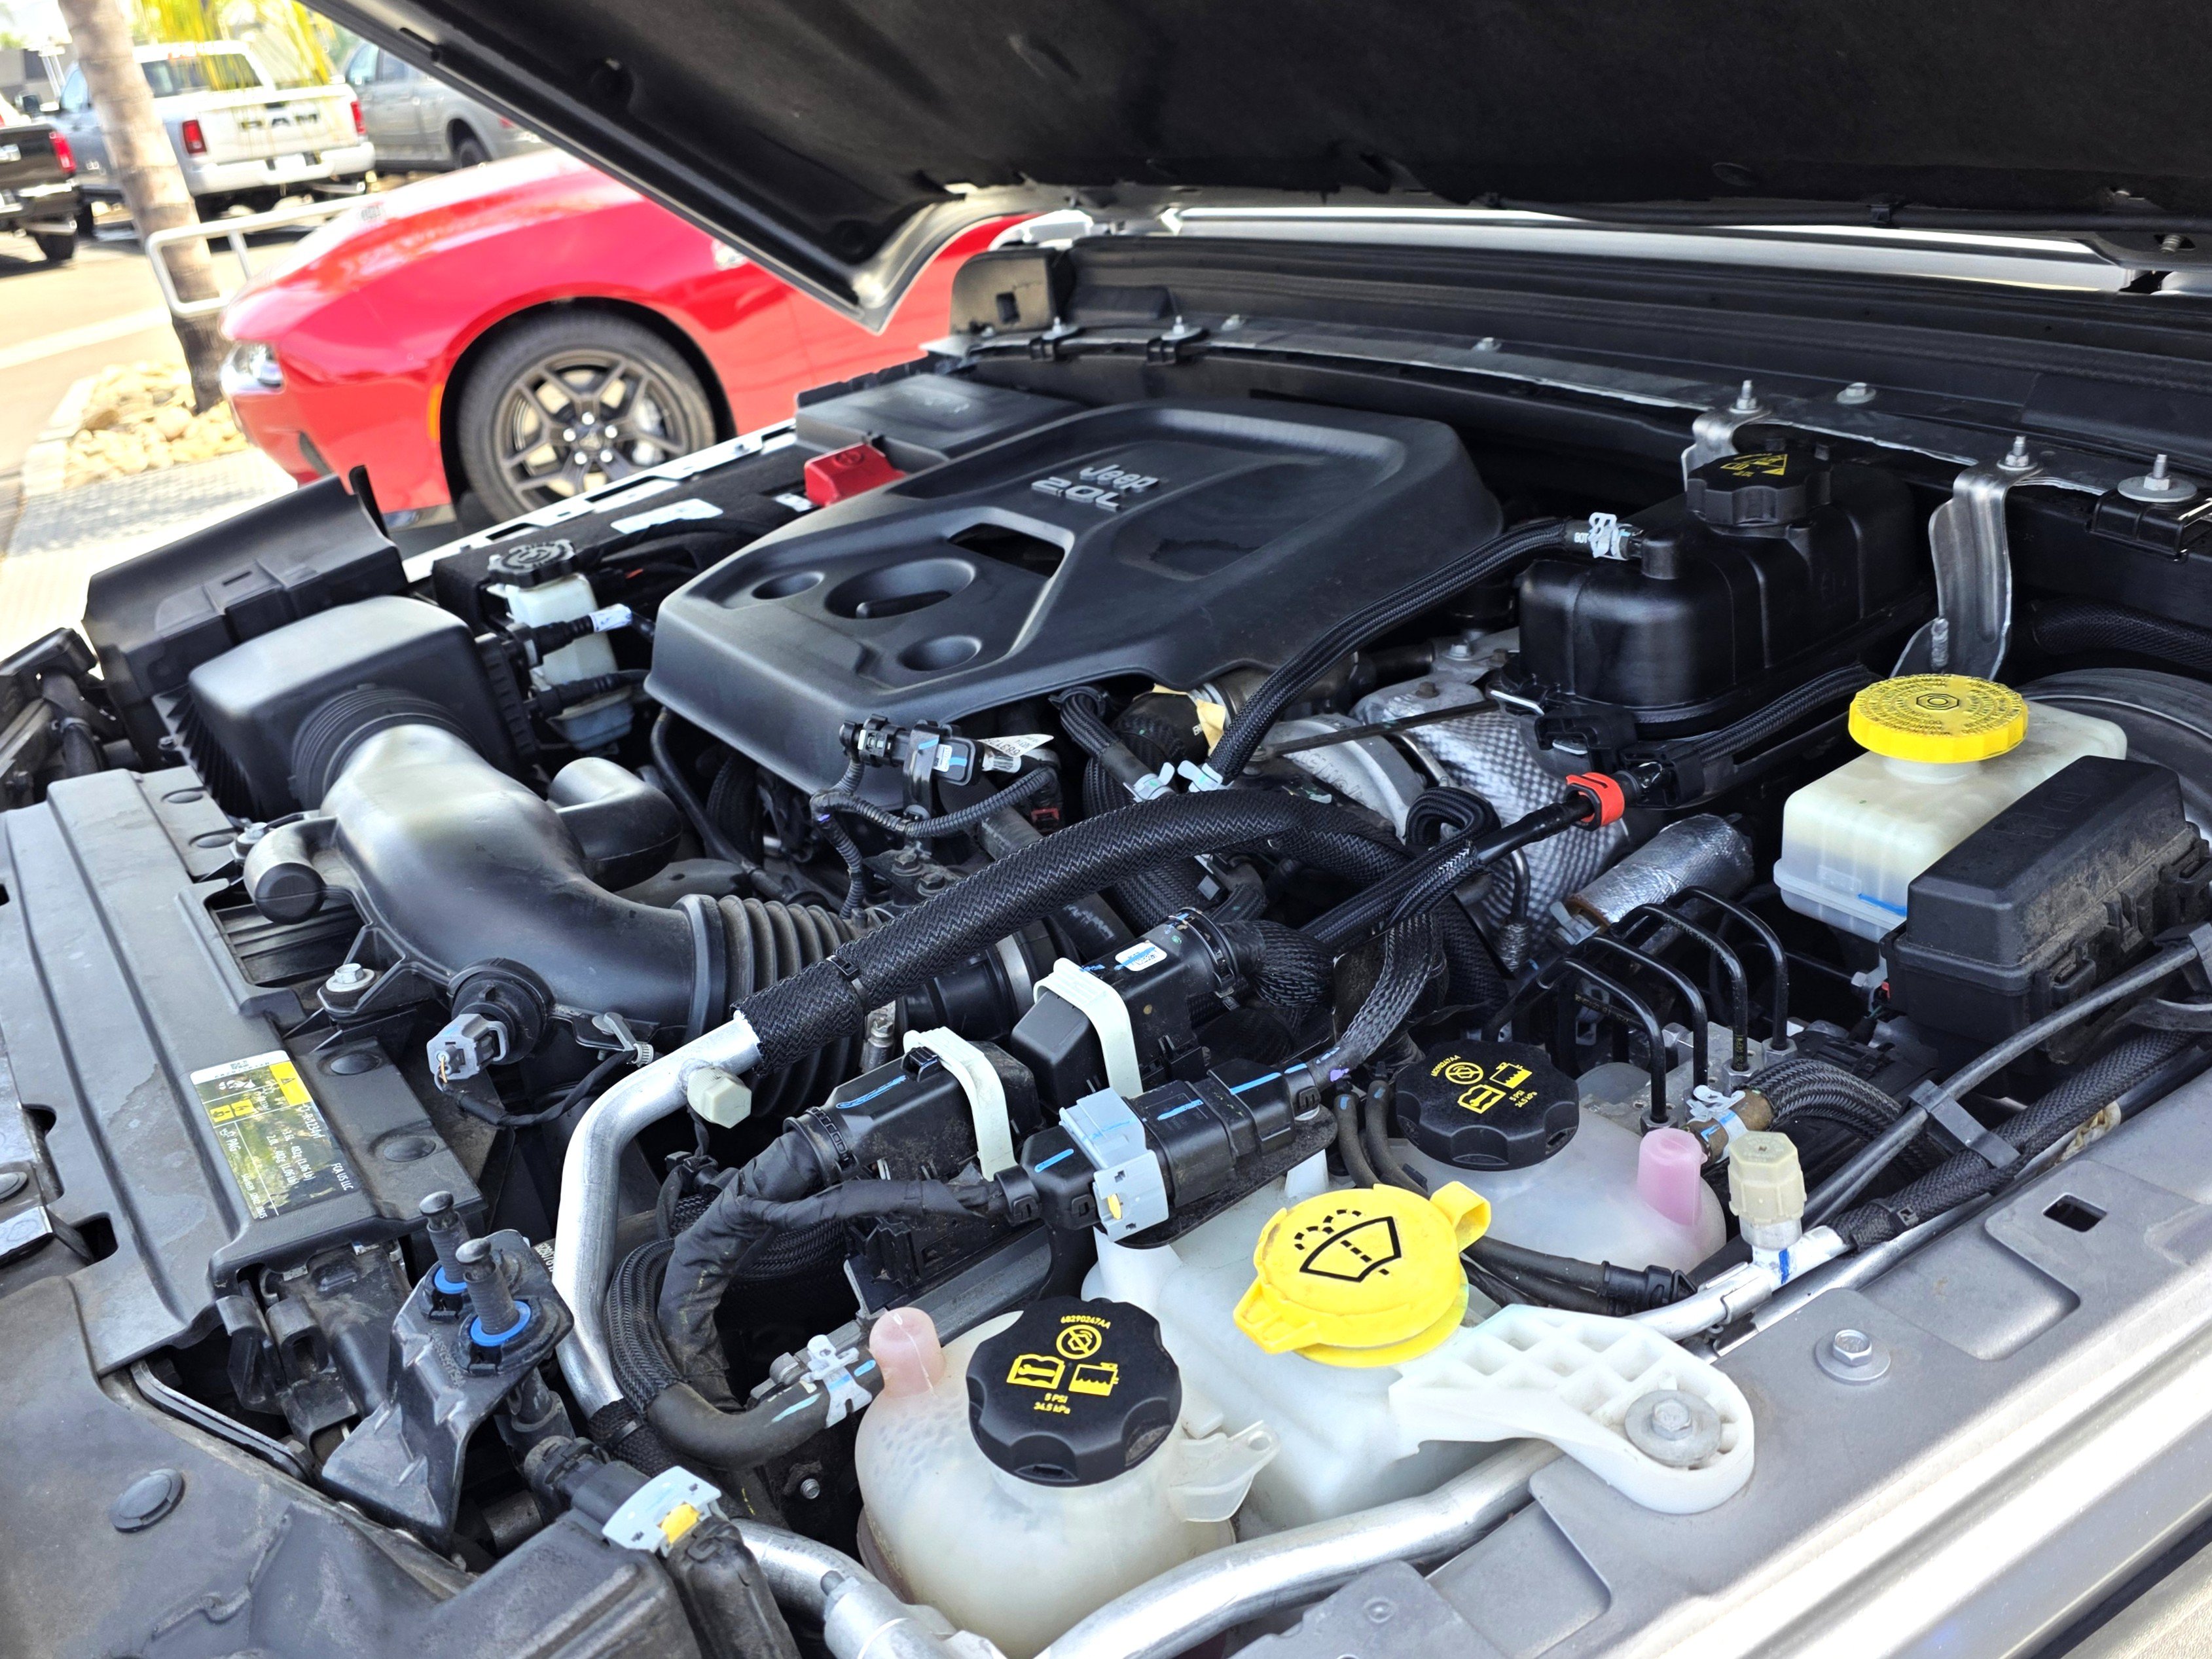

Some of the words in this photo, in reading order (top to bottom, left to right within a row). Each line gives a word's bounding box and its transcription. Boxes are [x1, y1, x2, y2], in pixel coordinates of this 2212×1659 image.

[240, 113, 318, 130] RAM
[1079, 464, 1159, 493] Jeep
[1031, 476, 1120, 512] 2.0L
[1513, 1089, 1525, 1099] PSI
[302, 1112, 325, 1139] R-1234yf
[226, 1138, 241, 1152] PAG
[331, 1163, 342, 1174] FCA
[338, 1172, 348, 1182] US
[342, 1180, 354, 1191] LLC
[1060, 1315, 1112, 1330] 68290247AA
[1044, 1393, 1053, 1402] 5
[1052, 1394, 1069, 1404] PSI
[1053, 1404, 1071, 1414] kPa
